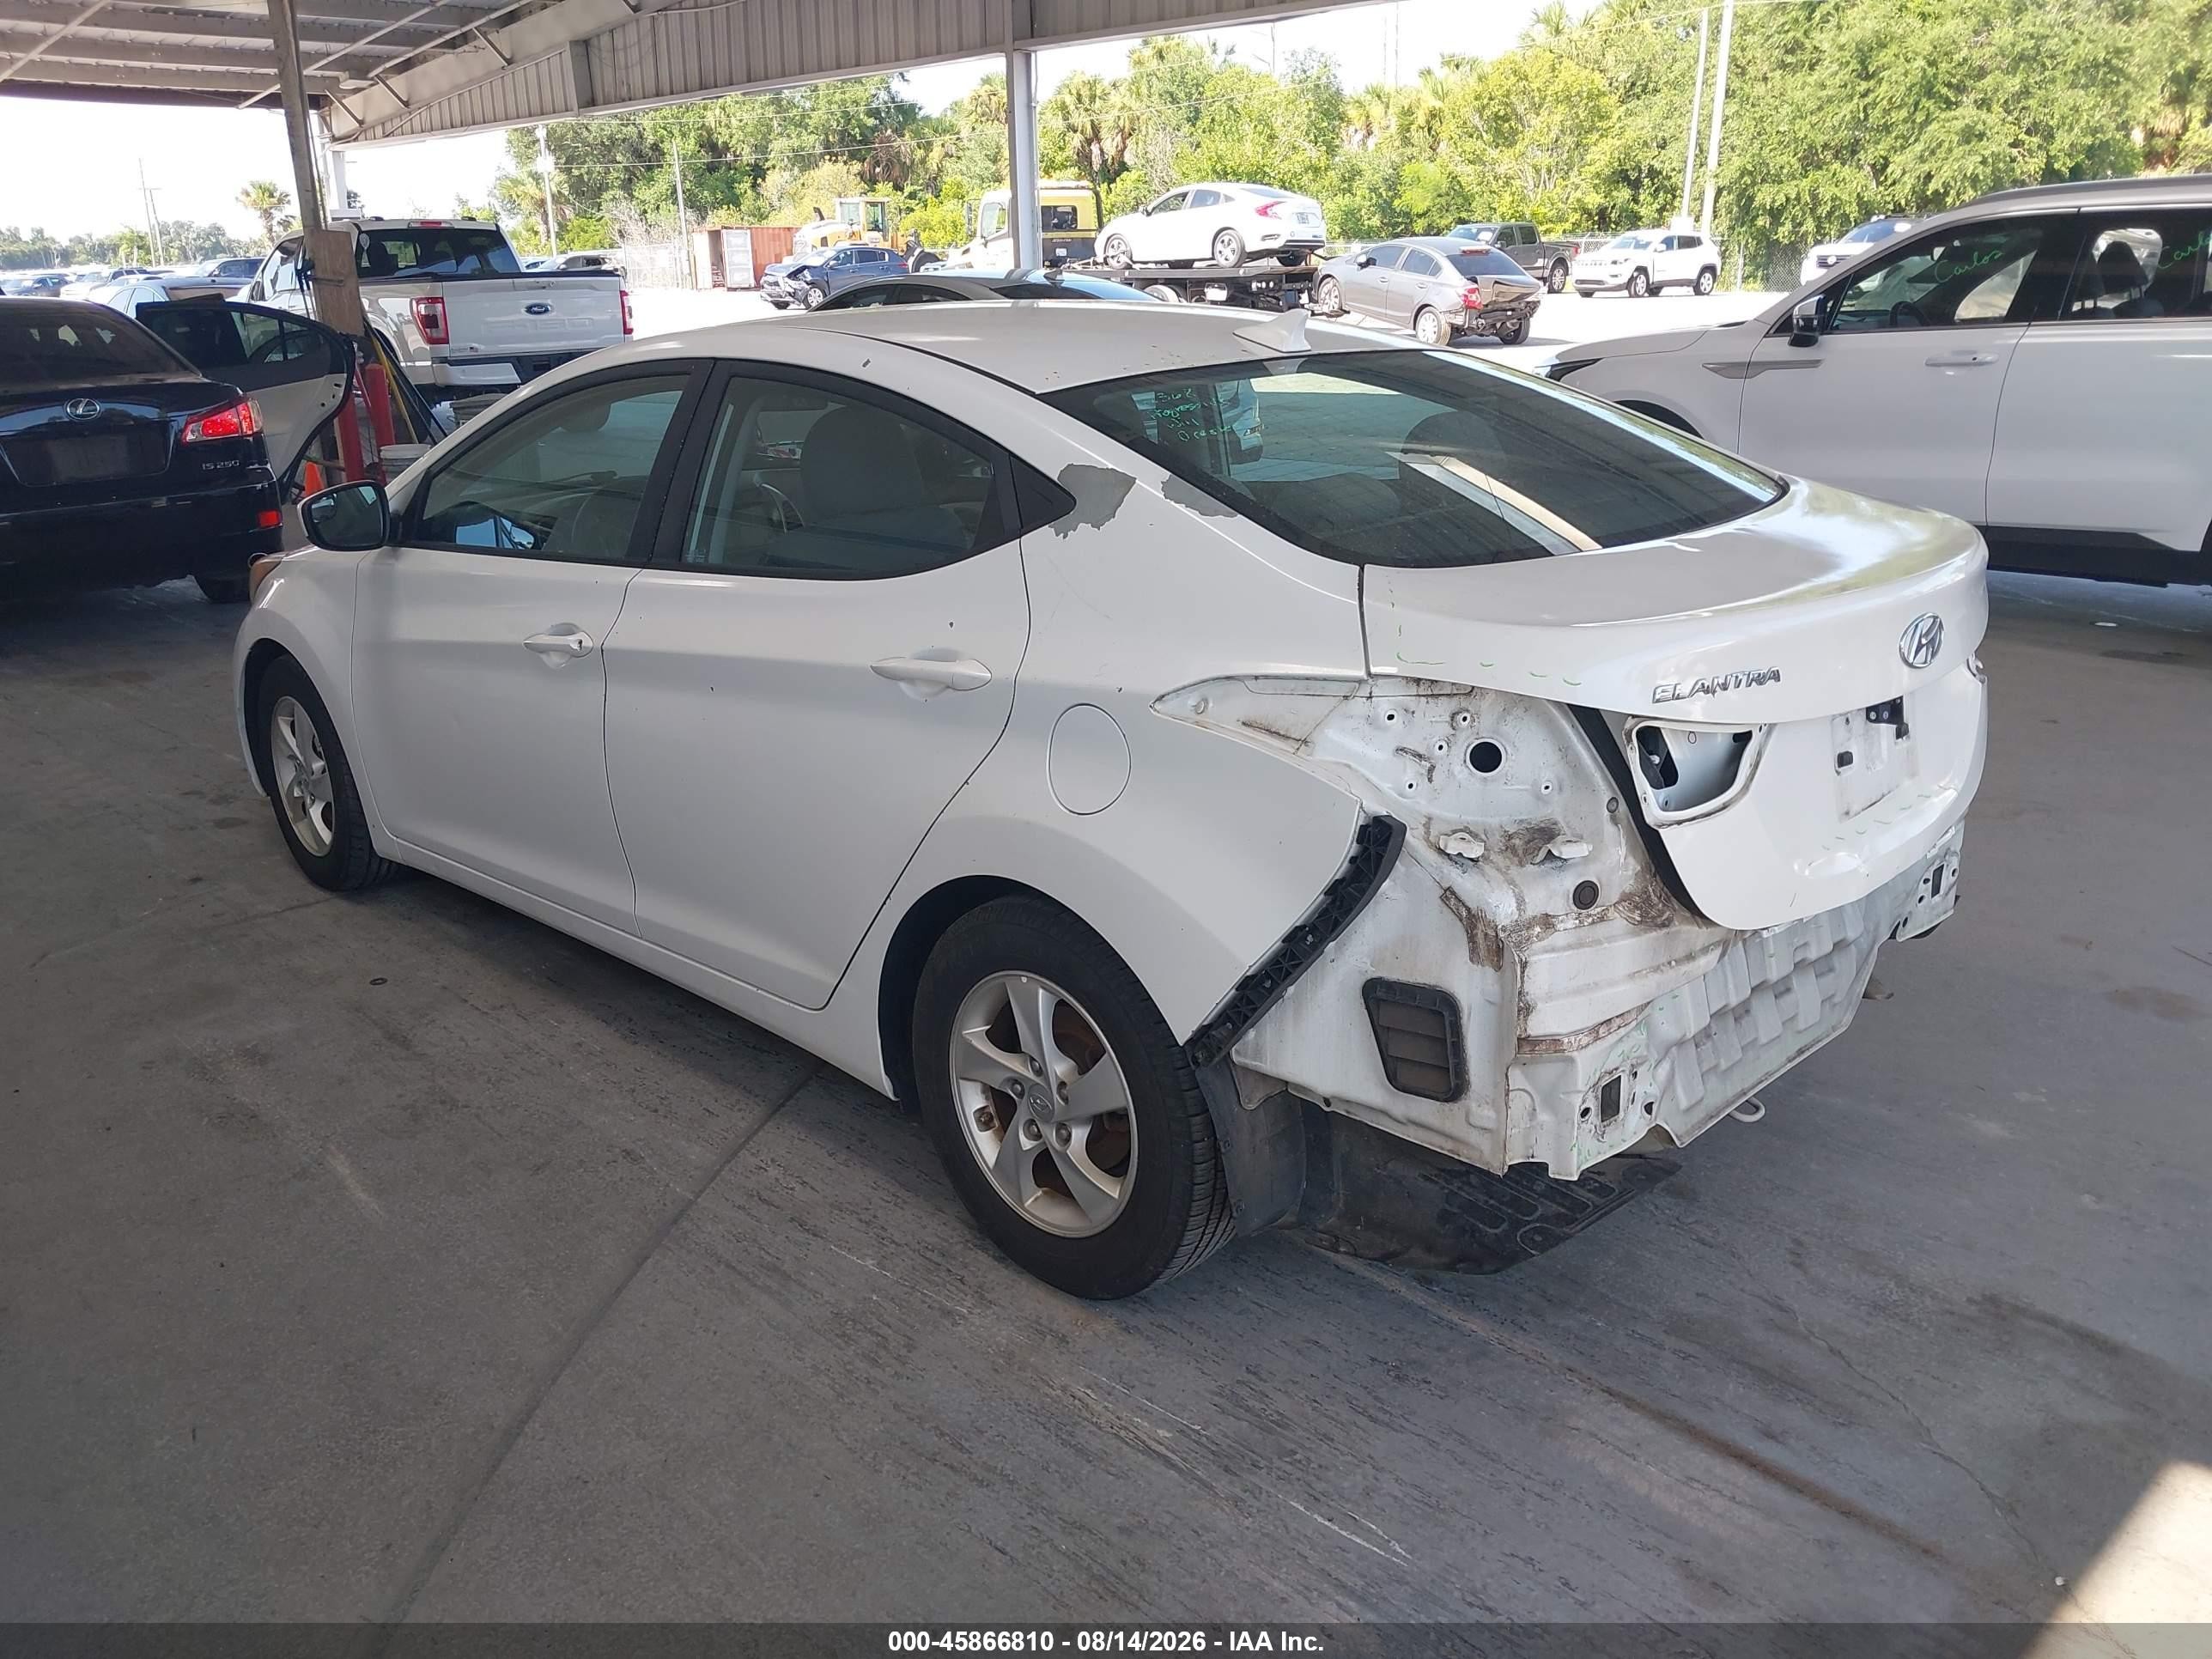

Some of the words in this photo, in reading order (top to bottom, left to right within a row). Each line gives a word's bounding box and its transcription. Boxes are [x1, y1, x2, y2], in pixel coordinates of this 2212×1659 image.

[1935, 250, 2006, 283] Carlos
[216, 459, 240, 469] 250
[1652, 665, 1781, 703] ELANTRA
